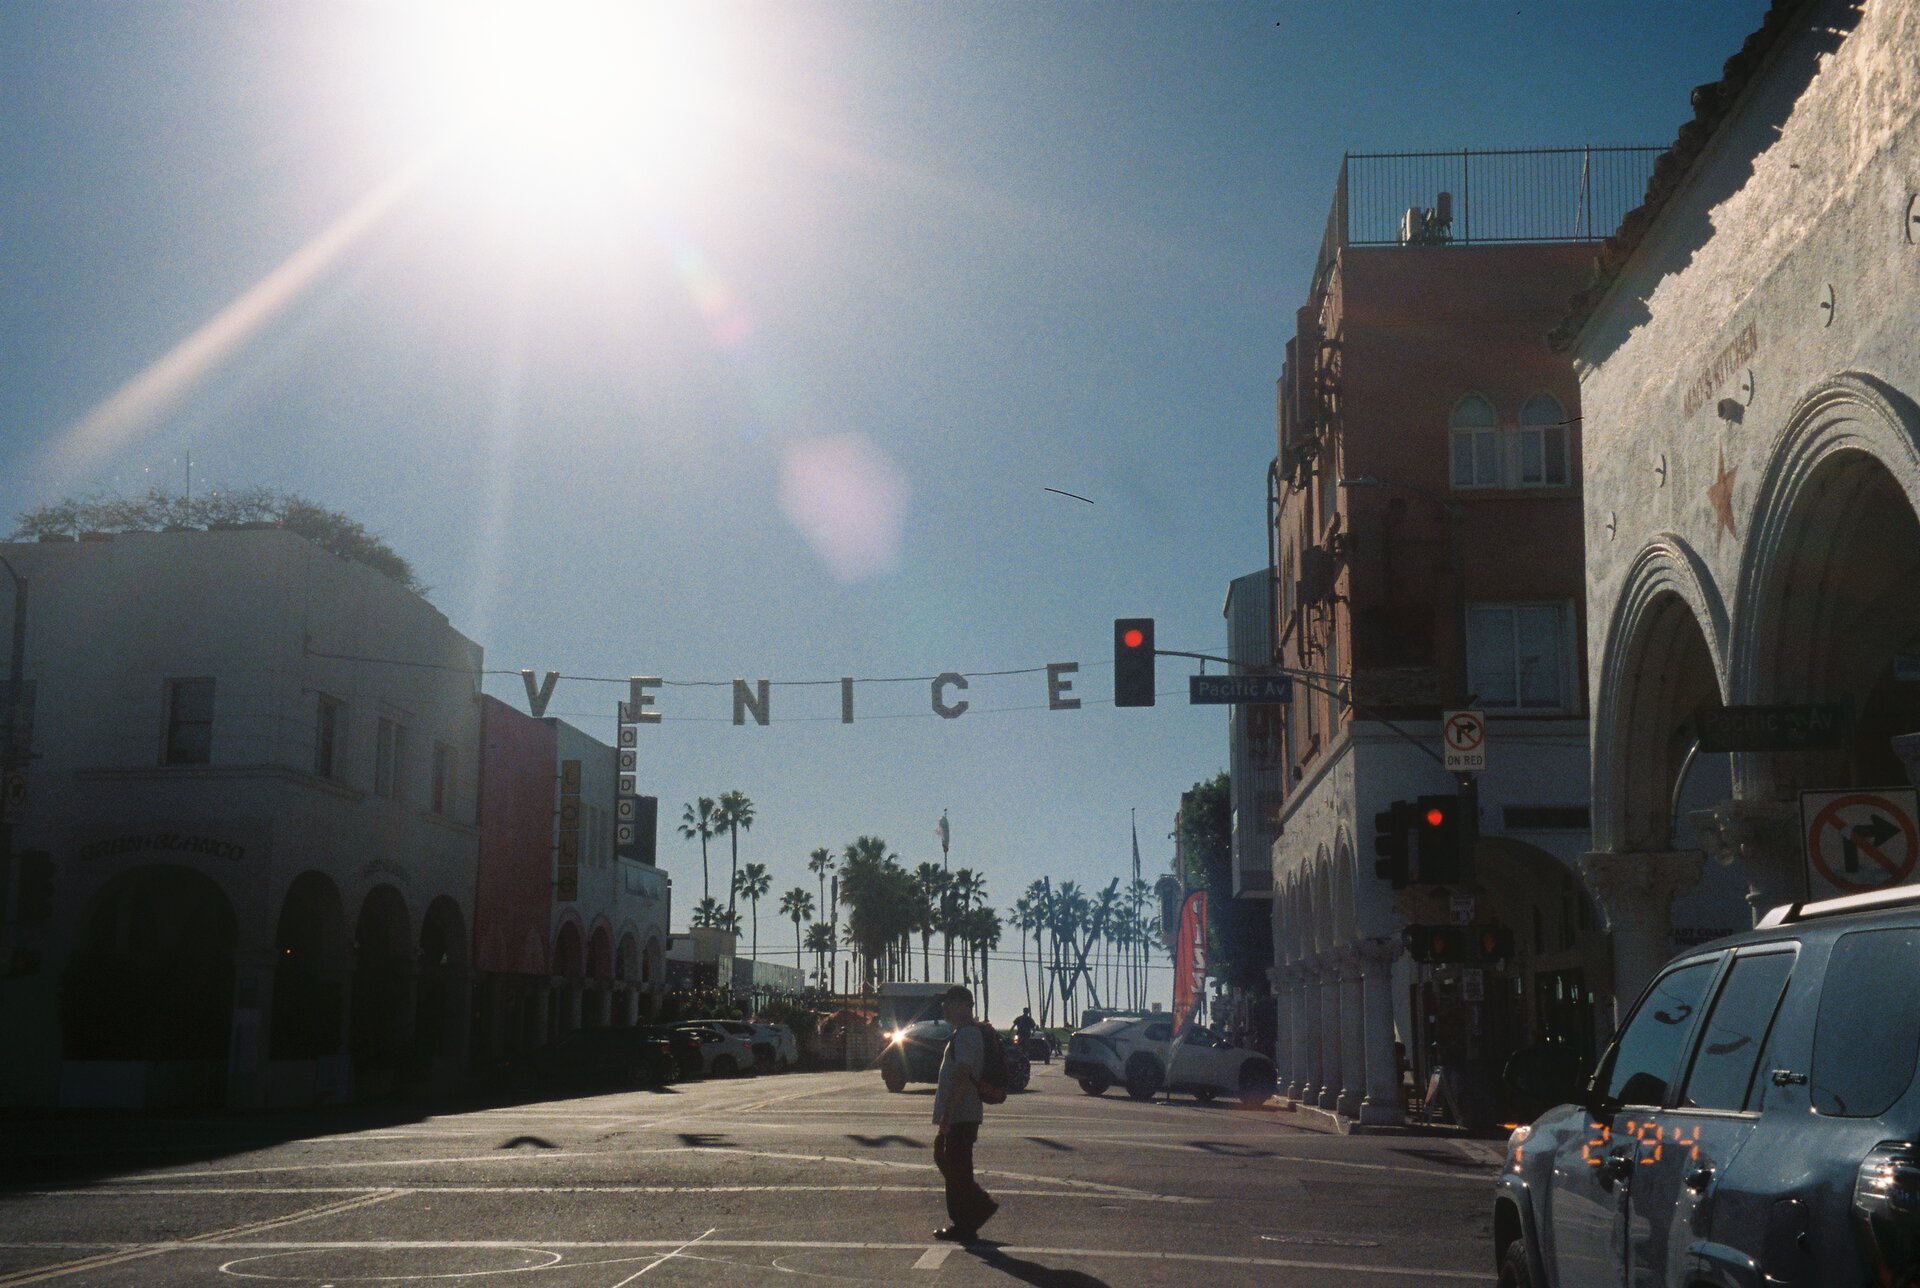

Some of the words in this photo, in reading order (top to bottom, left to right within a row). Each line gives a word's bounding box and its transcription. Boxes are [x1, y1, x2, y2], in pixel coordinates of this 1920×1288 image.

[1713, 318, 1758, 390] KITCHEN
[521, 662, 1081, 725] VENICE
[1199, 681, 1259, 696] Pacific
[1265, 682, 1285, 696] Av
[1704, 711, 1778, 732] Pacific
[1808, 707, 1833, 730] Av
[1447, 755, 1461, 766] ON
[1464, 755, 1483, 766] RED
